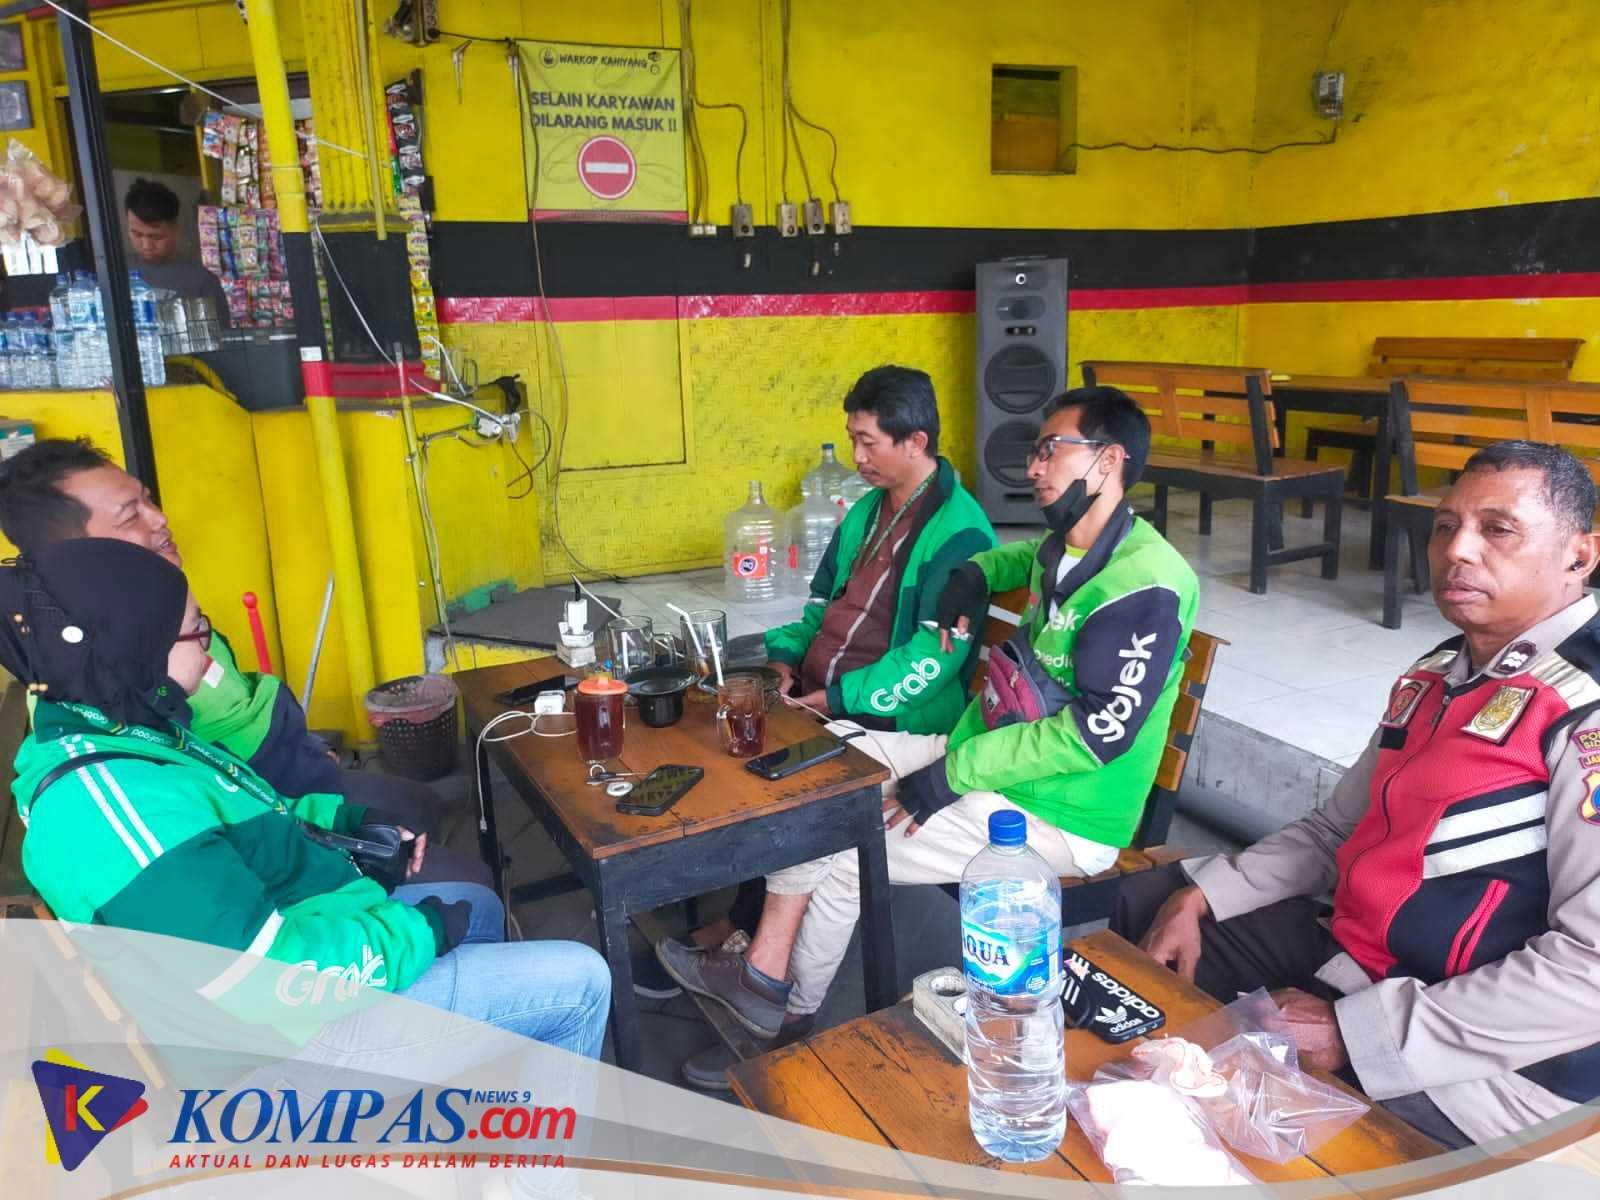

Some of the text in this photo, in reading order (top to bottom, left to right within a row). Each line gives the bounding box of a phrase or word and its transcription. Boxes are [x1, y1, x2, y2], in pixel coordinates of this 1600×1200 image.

[530, 91, 676, 111] SELAIN KARYAWAN
[531, 114, 609, 129] DILARANG
[612, 116, 664, 131] MASUK
[870, 657, 941, 712] Grab
[1087, 632, 1158, 743] gojek
[274, 944, 388, 1007] Grab
[1091, 971, 1160, 1019] adidas
